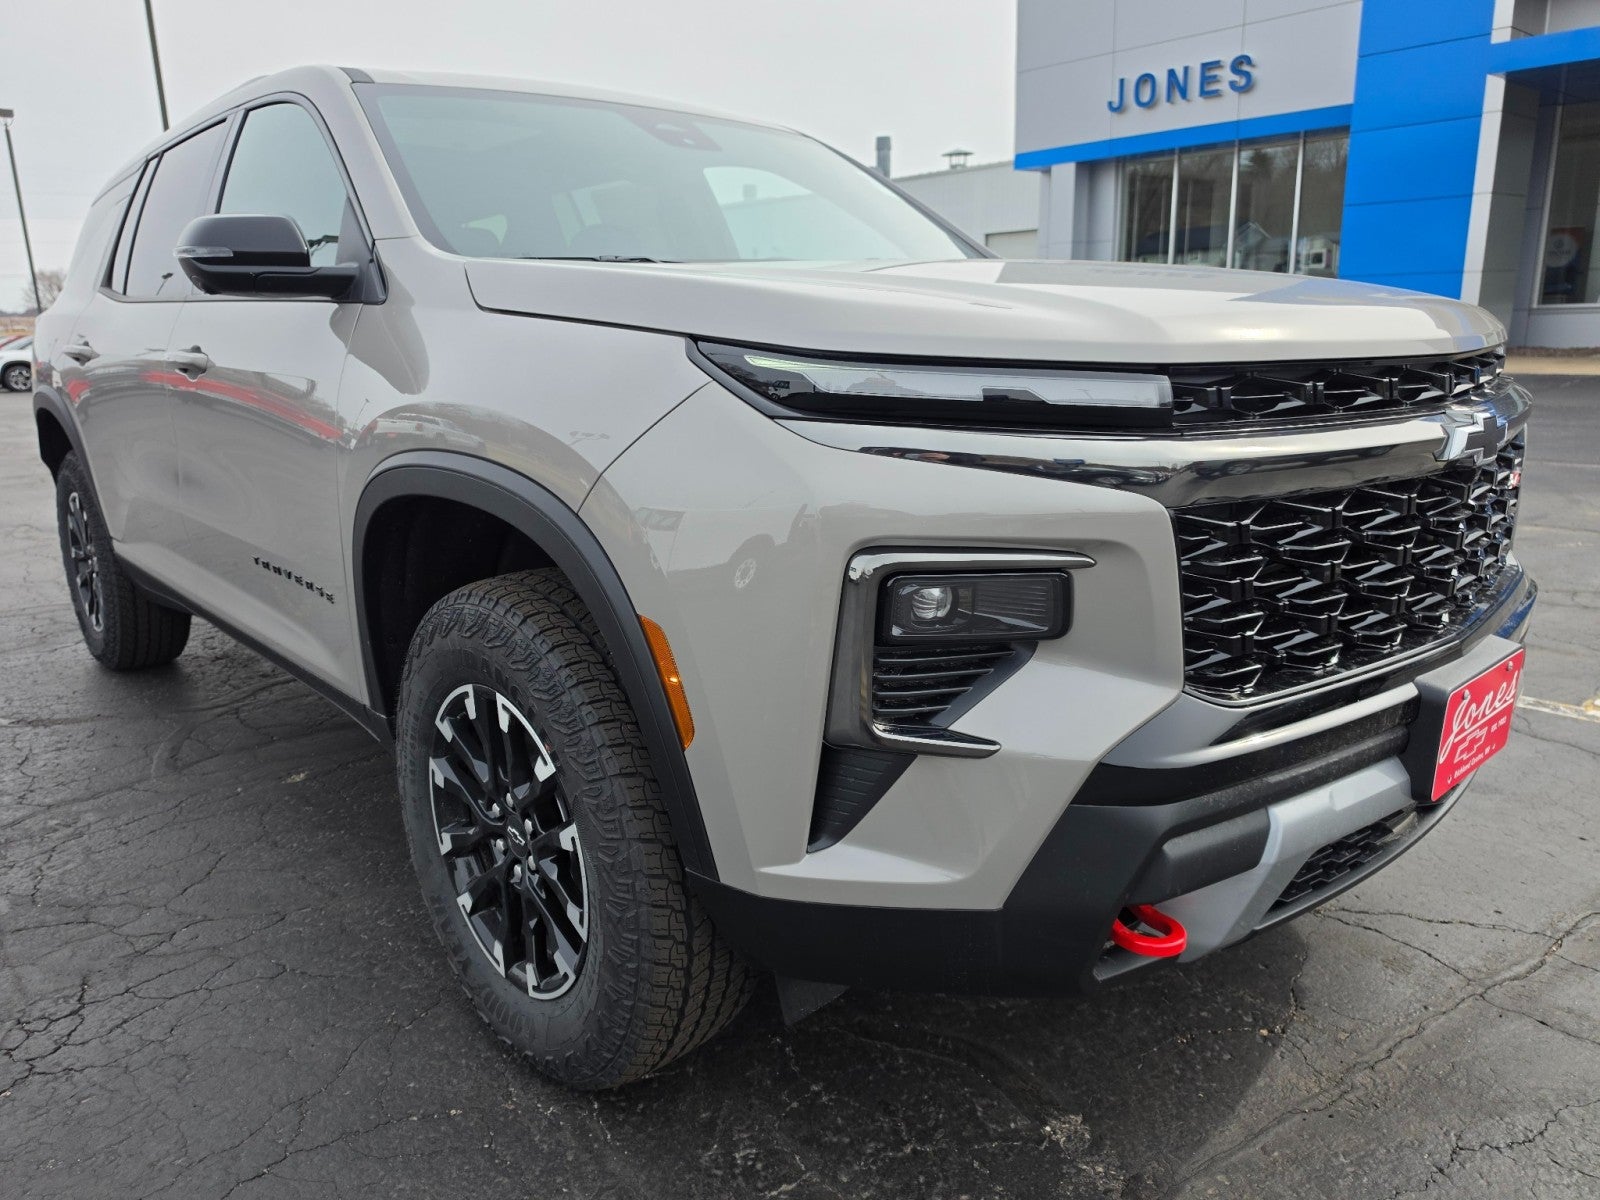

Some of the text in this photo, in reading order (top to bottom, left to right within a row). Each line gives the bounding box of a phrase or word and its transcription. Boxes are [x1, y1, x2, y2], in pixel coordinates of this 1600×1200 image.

[1107, 54, 1255, 113] JONES
[252, 556, 334, 604] TRAVERSE
[1438, 670, 1519, 764] Jones
